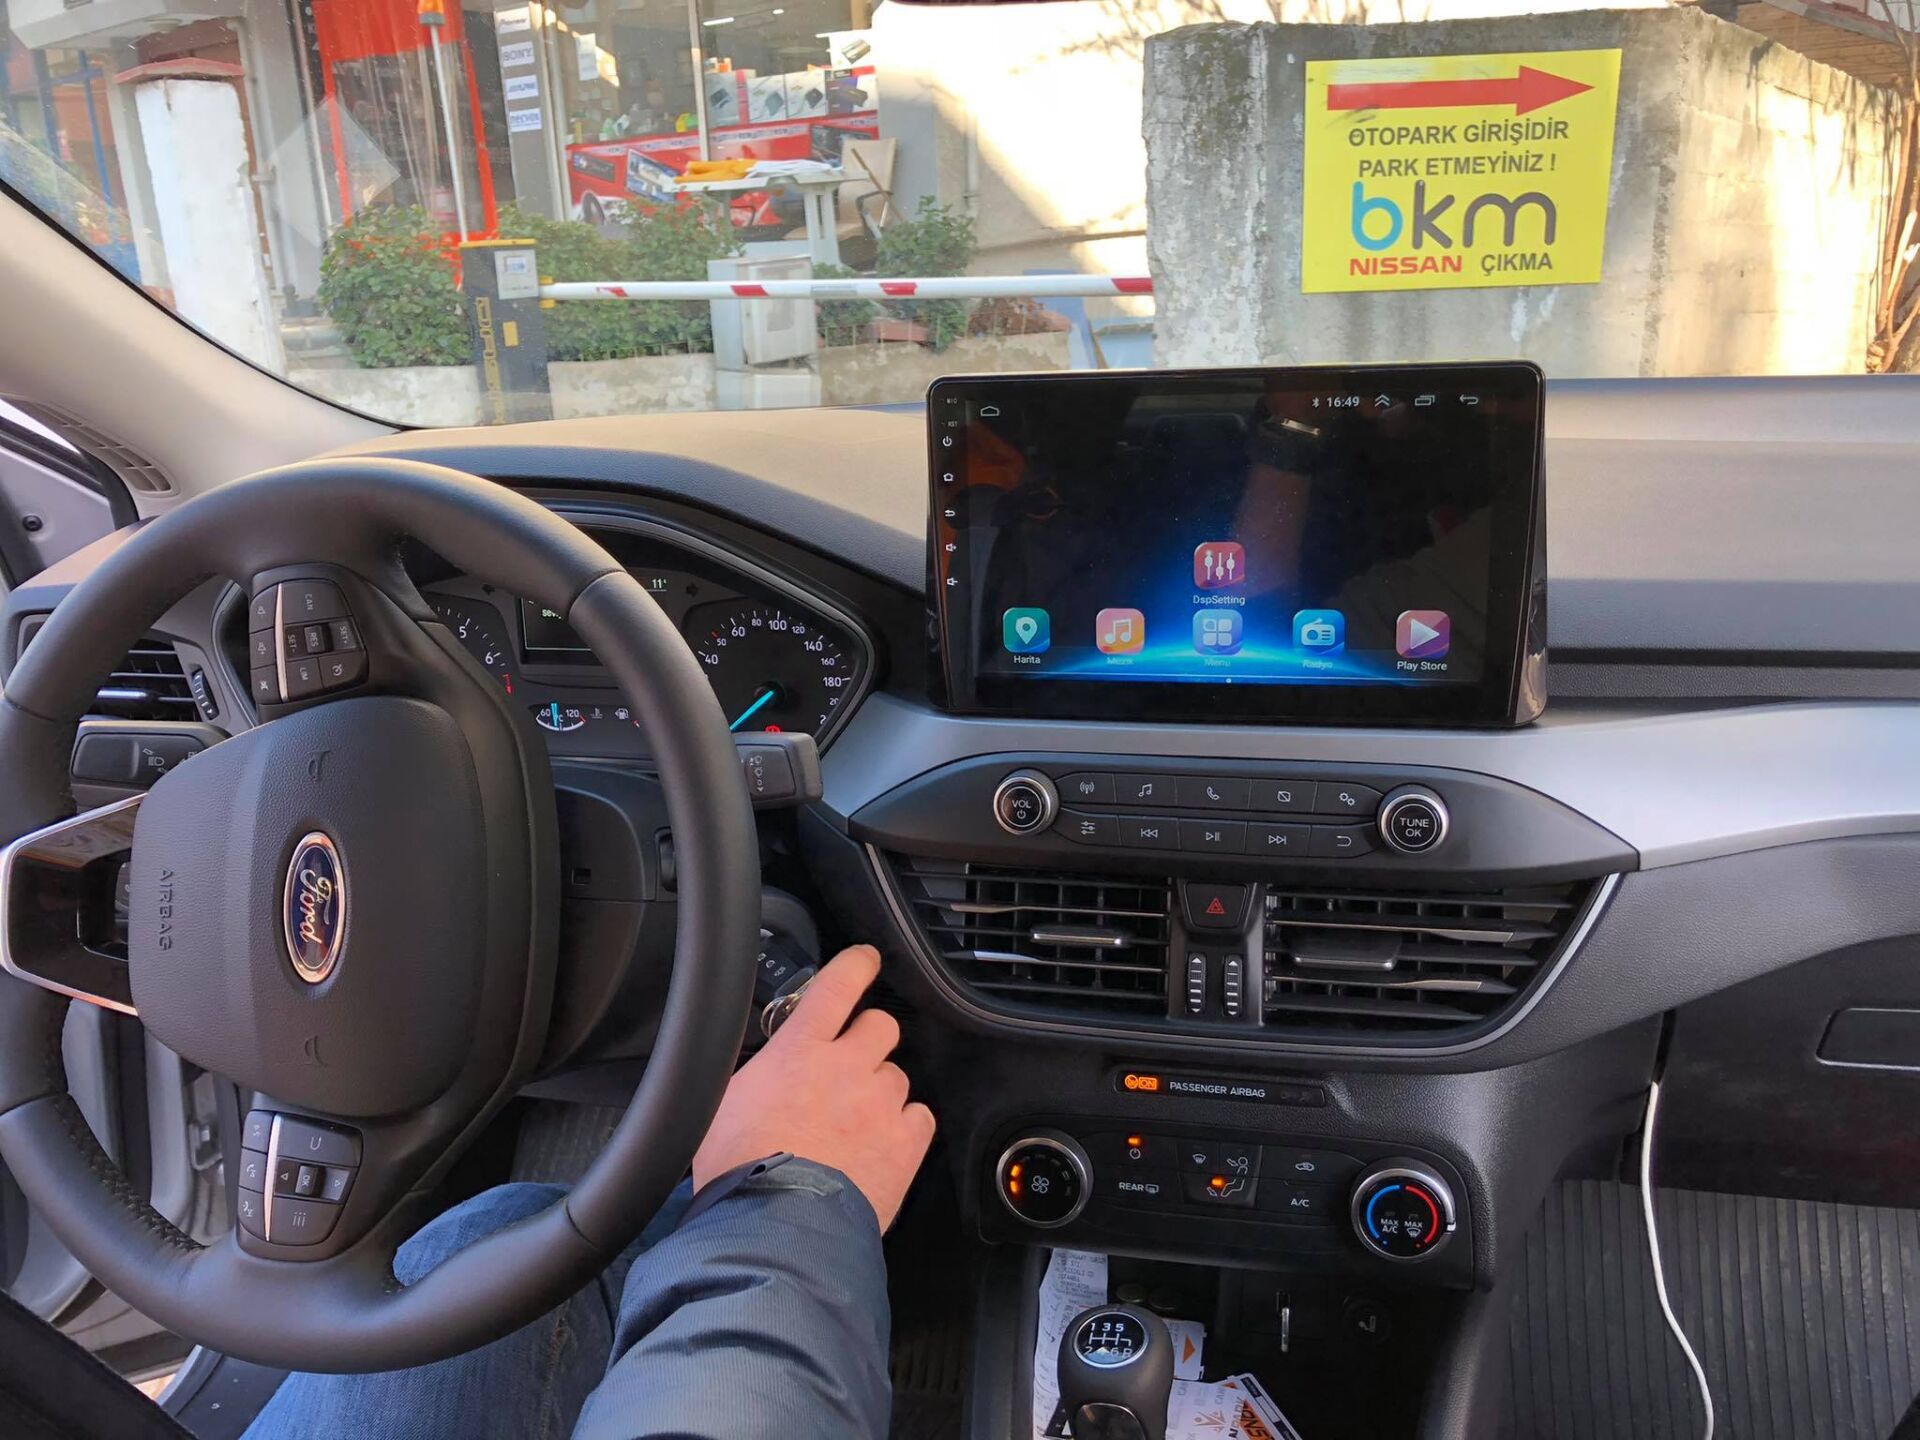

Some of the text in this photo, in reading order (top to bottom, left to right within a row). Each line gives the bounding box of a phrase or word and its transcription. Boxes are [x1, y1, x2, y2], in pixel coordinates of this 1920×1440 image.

[1349, 117, 1569, 147] OTOPARK GİRİŞİDİR
[1358, 158, 1419, 178] PARK
[1426, 150, 1544, 177] ETMEYİNİZ
[1351, 180, 1557, 251] bkm
[1349, 253, 1553, 276] NISSAN ÇIKMA
[1327, 396, 1360, 407] 16:49
[1193, 595, 1246, 606] DspSetting
[751, 618, 762, 627] 80
[768, 620, 787, 631] 100
[458, 626, 467, 638] 5
[731, 627, 746, 637] 60
[792, 625, 806, 634] 120
[309, 632, 319, 647] RES
[716, 638, 727, 646] 50
[804, 640, 823, 651] 140
[485, 652, 494, 664] 6
[704, 654, 719, 665] 40
[820, 657, 835, 666] 160
[1013, 655, 1041, 665] Harita
[1397, 661, 1448, 672] Play Store
[823, 676, 842, 687] 180
[540, 708, 551, 717] 60
[566, 709, 580, 717] 120
[1011, 799, 1032, 809] VOL
[1400, 817, 1430, 828] TUNE
[1405, 828, 1422, 837] OK
[159, 867, 174, 951] AIRBAG
[299, 868, 332, 945] Ford
[1141, 1079, 1156, 1088] ON
[1169, 1081, 1228, 1095] PASSENGER
[1230, 1086, 1266, 1099] AIRBAG
[1118, 1182, 1145, 1193] REAR
[1290, 1198, 1310, 1208] A/C
[1380, 1218, 1399, 1227] MAX
[1404, 1220, 1423, 1229] MAX
[1382, 1226, 1398, 1235] A/C
[1090, 1322, 1124, 1332] 1 3 5
[1111, 1346, 1119, 1357] 6
[1122, 1347, 1133, 1358] R
